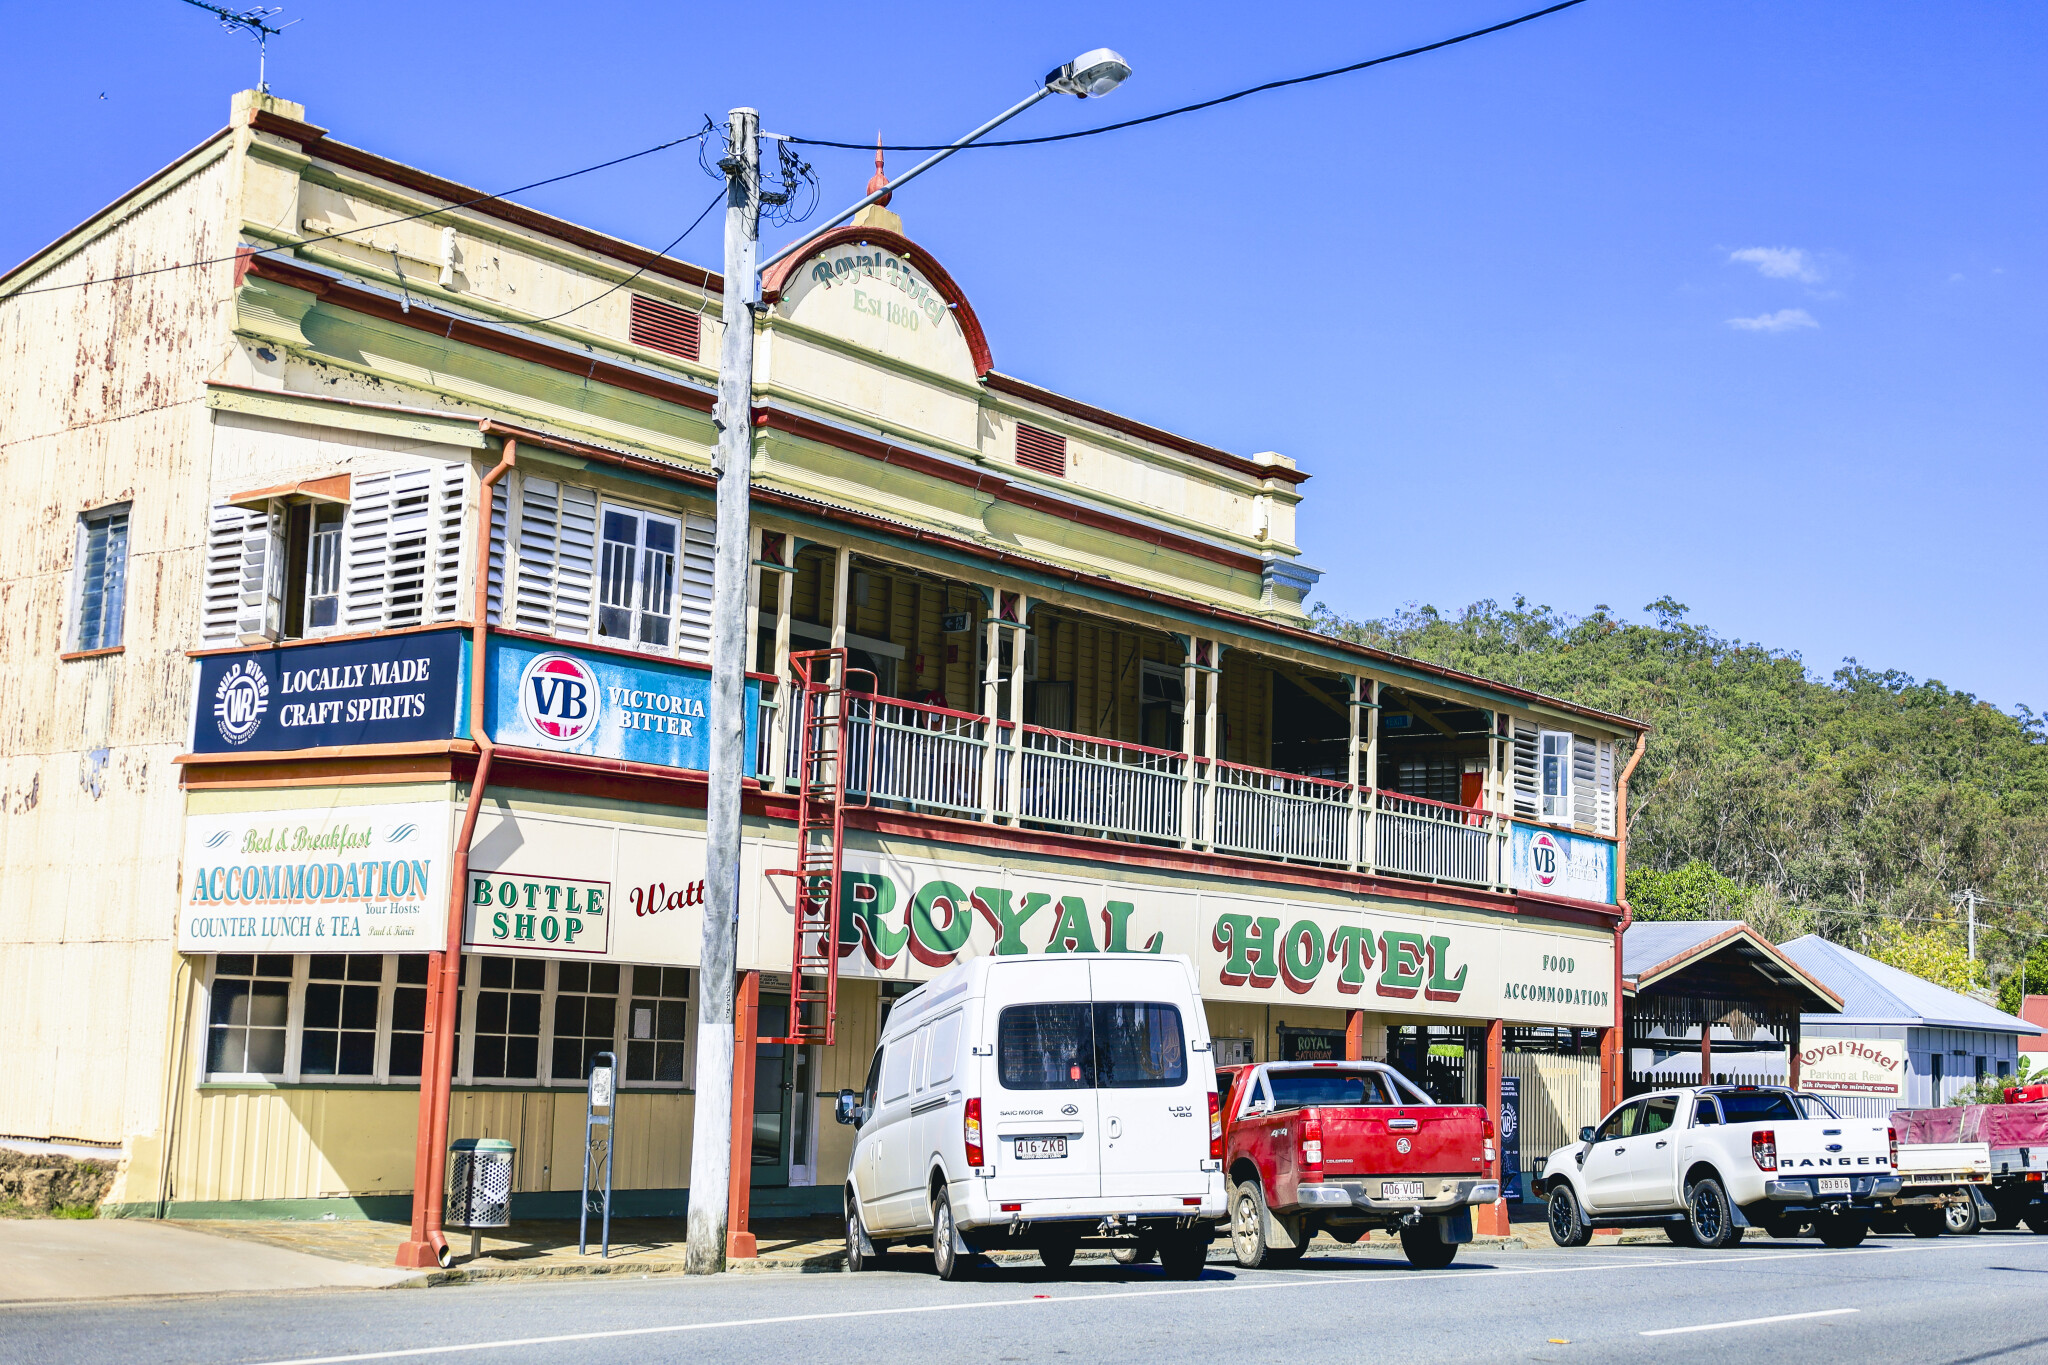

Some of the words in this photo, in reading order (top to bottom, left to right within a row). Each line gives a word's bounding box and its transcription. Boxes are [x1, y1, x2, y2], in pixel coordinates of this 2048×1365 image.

[812, 252, 881, 290] Royal
[885, 257, 947, 328] Hotel
[887, 301, 919, 332] 1880
[215, 663, 241, 700] WILD
[245, 659, 270, 697] RIVER
[281, 664, 369, 694] LOCALLY
[370, 657, 431, 686] MADE
[279, 699, 344, 728] CRAFT
[346, 693, 426, 723] SPIRITS
[532, 676, 587, 719] VB
[607, 686, 706, 719] VICTORIA
[618, 711, 694, 738] BITTER
[241, 828, 275, 854] Bed
[275, 827, 289, 851] &
[291, 824, 372, 856] Breakfast
[1532, 847, 1556, 873] VB
[189, 859, 431, 906] ACCOMMODATION
[472, 878, 604, 915] BOTTLE
[365, 902, 387, 914] Your
[390, 902, 420, 914] Hosts:
[191, 917, 257, 938] COUNTER
[261, 916, 312, 937] LUNCH
[315, 917, 325, 937] &
[330, 916, 361, 937] TEA
[491, 912, 584, 944] SHOP
[803, 868, 1165, 969] ROYAL
[1212, 912, 1469, 1003] HOTEL
[1542, 954, 1575, 974] FOOD
[1503, 982, 1609, 1007] ACCOMMODATION
[1295, 1050, 1333, 1061] SATURDAY
[1297, 1036, 1331, 1051] ROYAL
[1845, 1041, 1899, 1072] Hotel
[1809, 1069, 1846, 1082] Parking
[1848, 1071, 1857, 1081] at
[1862, 1070, 1884, 1082] Rear
[1814, 1080, 1841, 1090] through
[1849, 1083, 1873, 1092] mining
[1874, 1084, 1895, 1092] centre
[1780, 1156, 1888, 1167] RANGER
